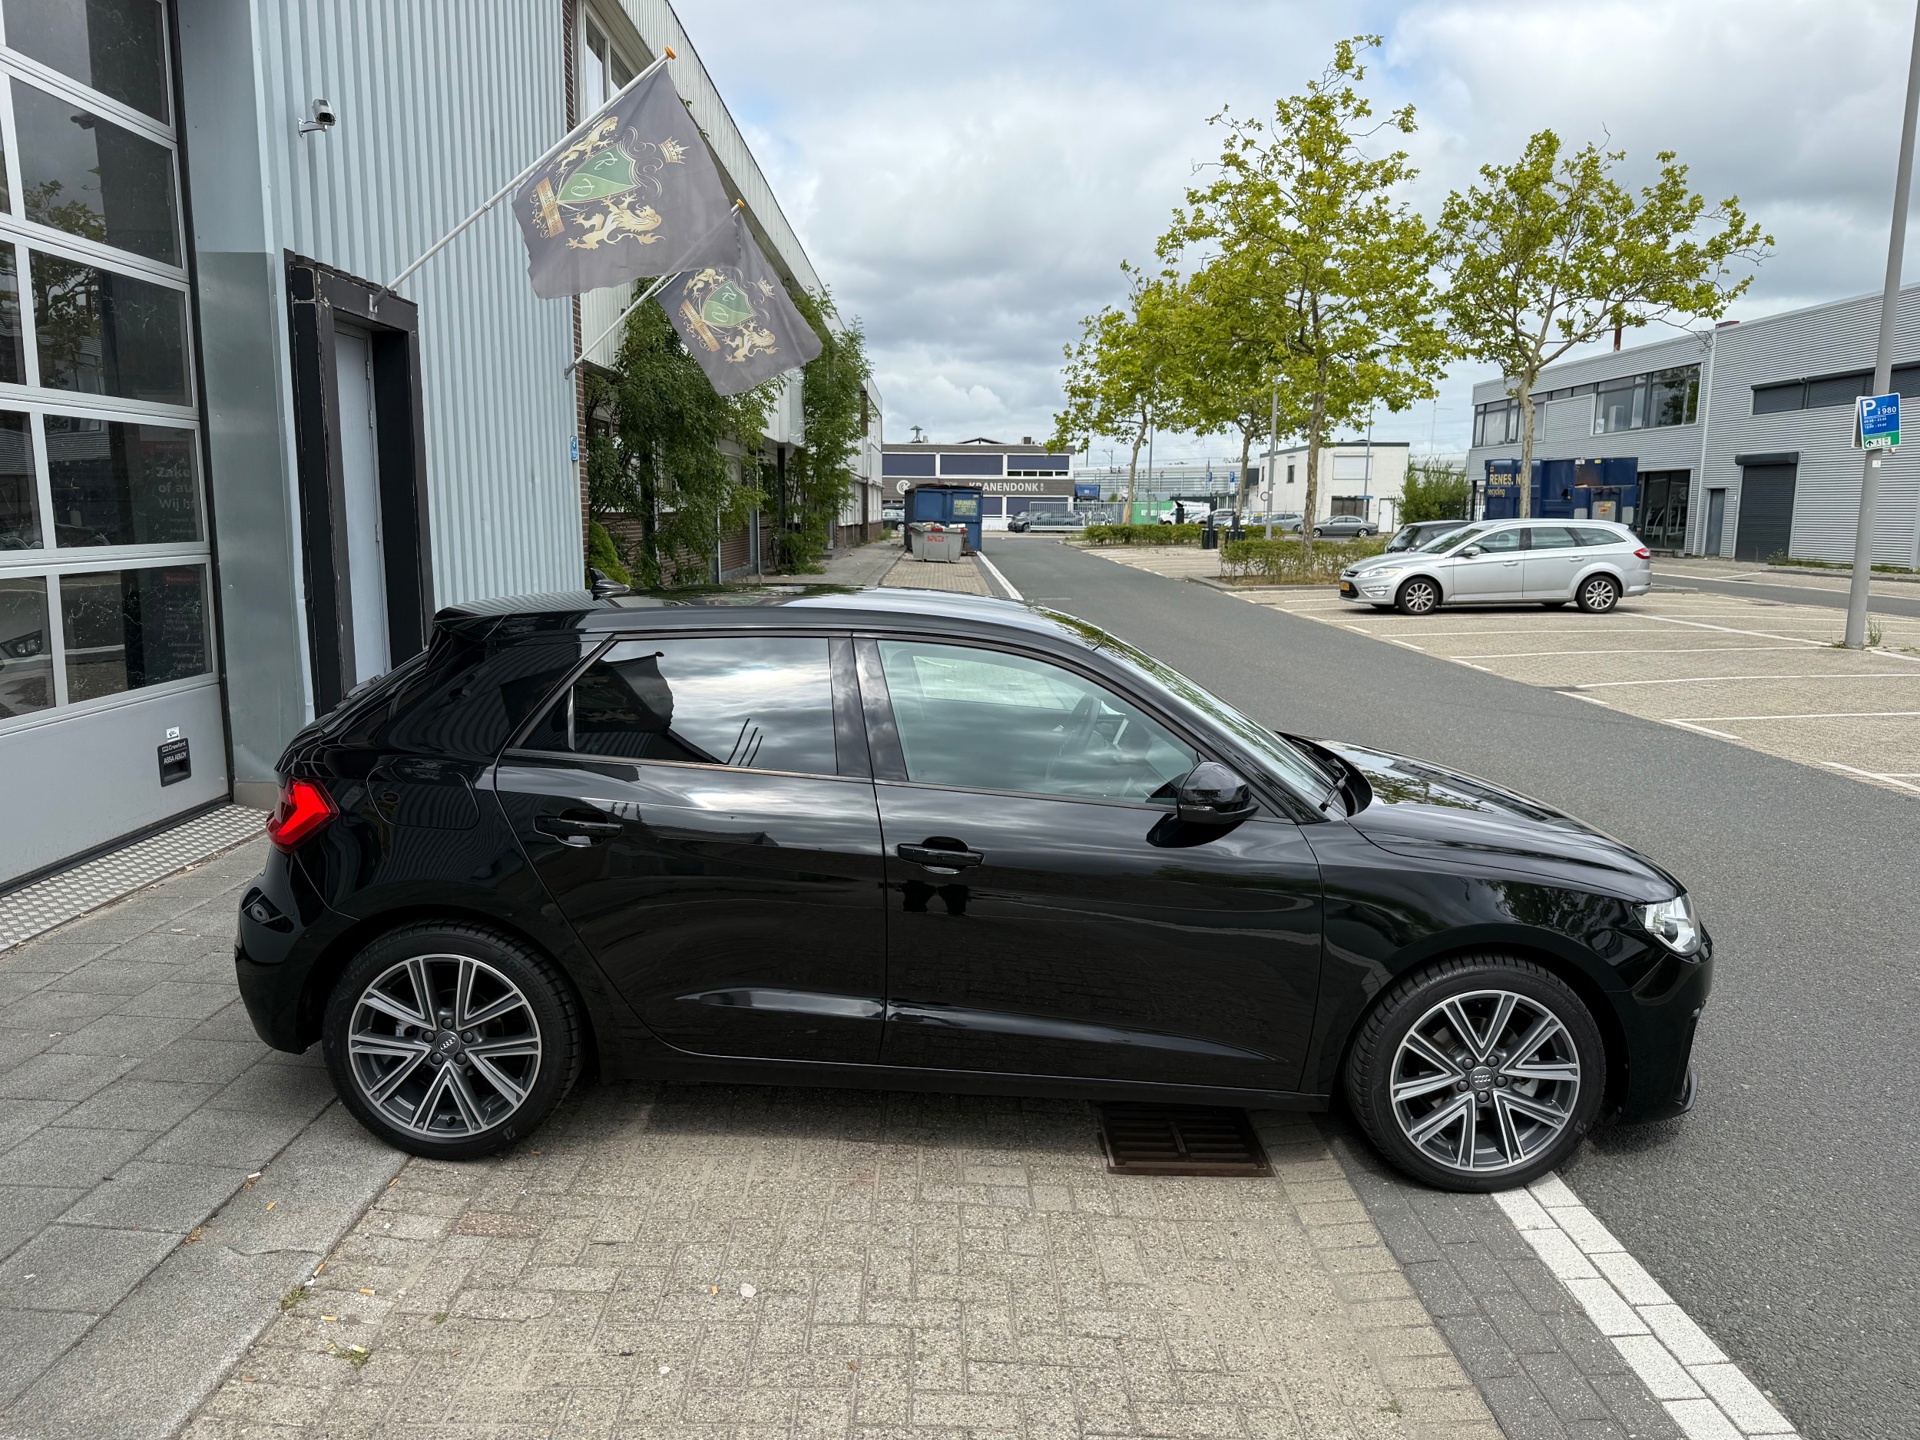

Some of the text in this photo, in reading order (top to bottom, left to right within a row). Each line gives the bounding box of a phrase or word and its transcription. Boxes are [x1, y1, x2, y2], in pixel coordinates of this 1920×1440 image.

[1862, 399, 1877, 417] P
[1882, 406, 1896, 414] 980
[1488, 488, 1505, 498] recycling
[164, 752, 187, 764] ASSA ABLOY
